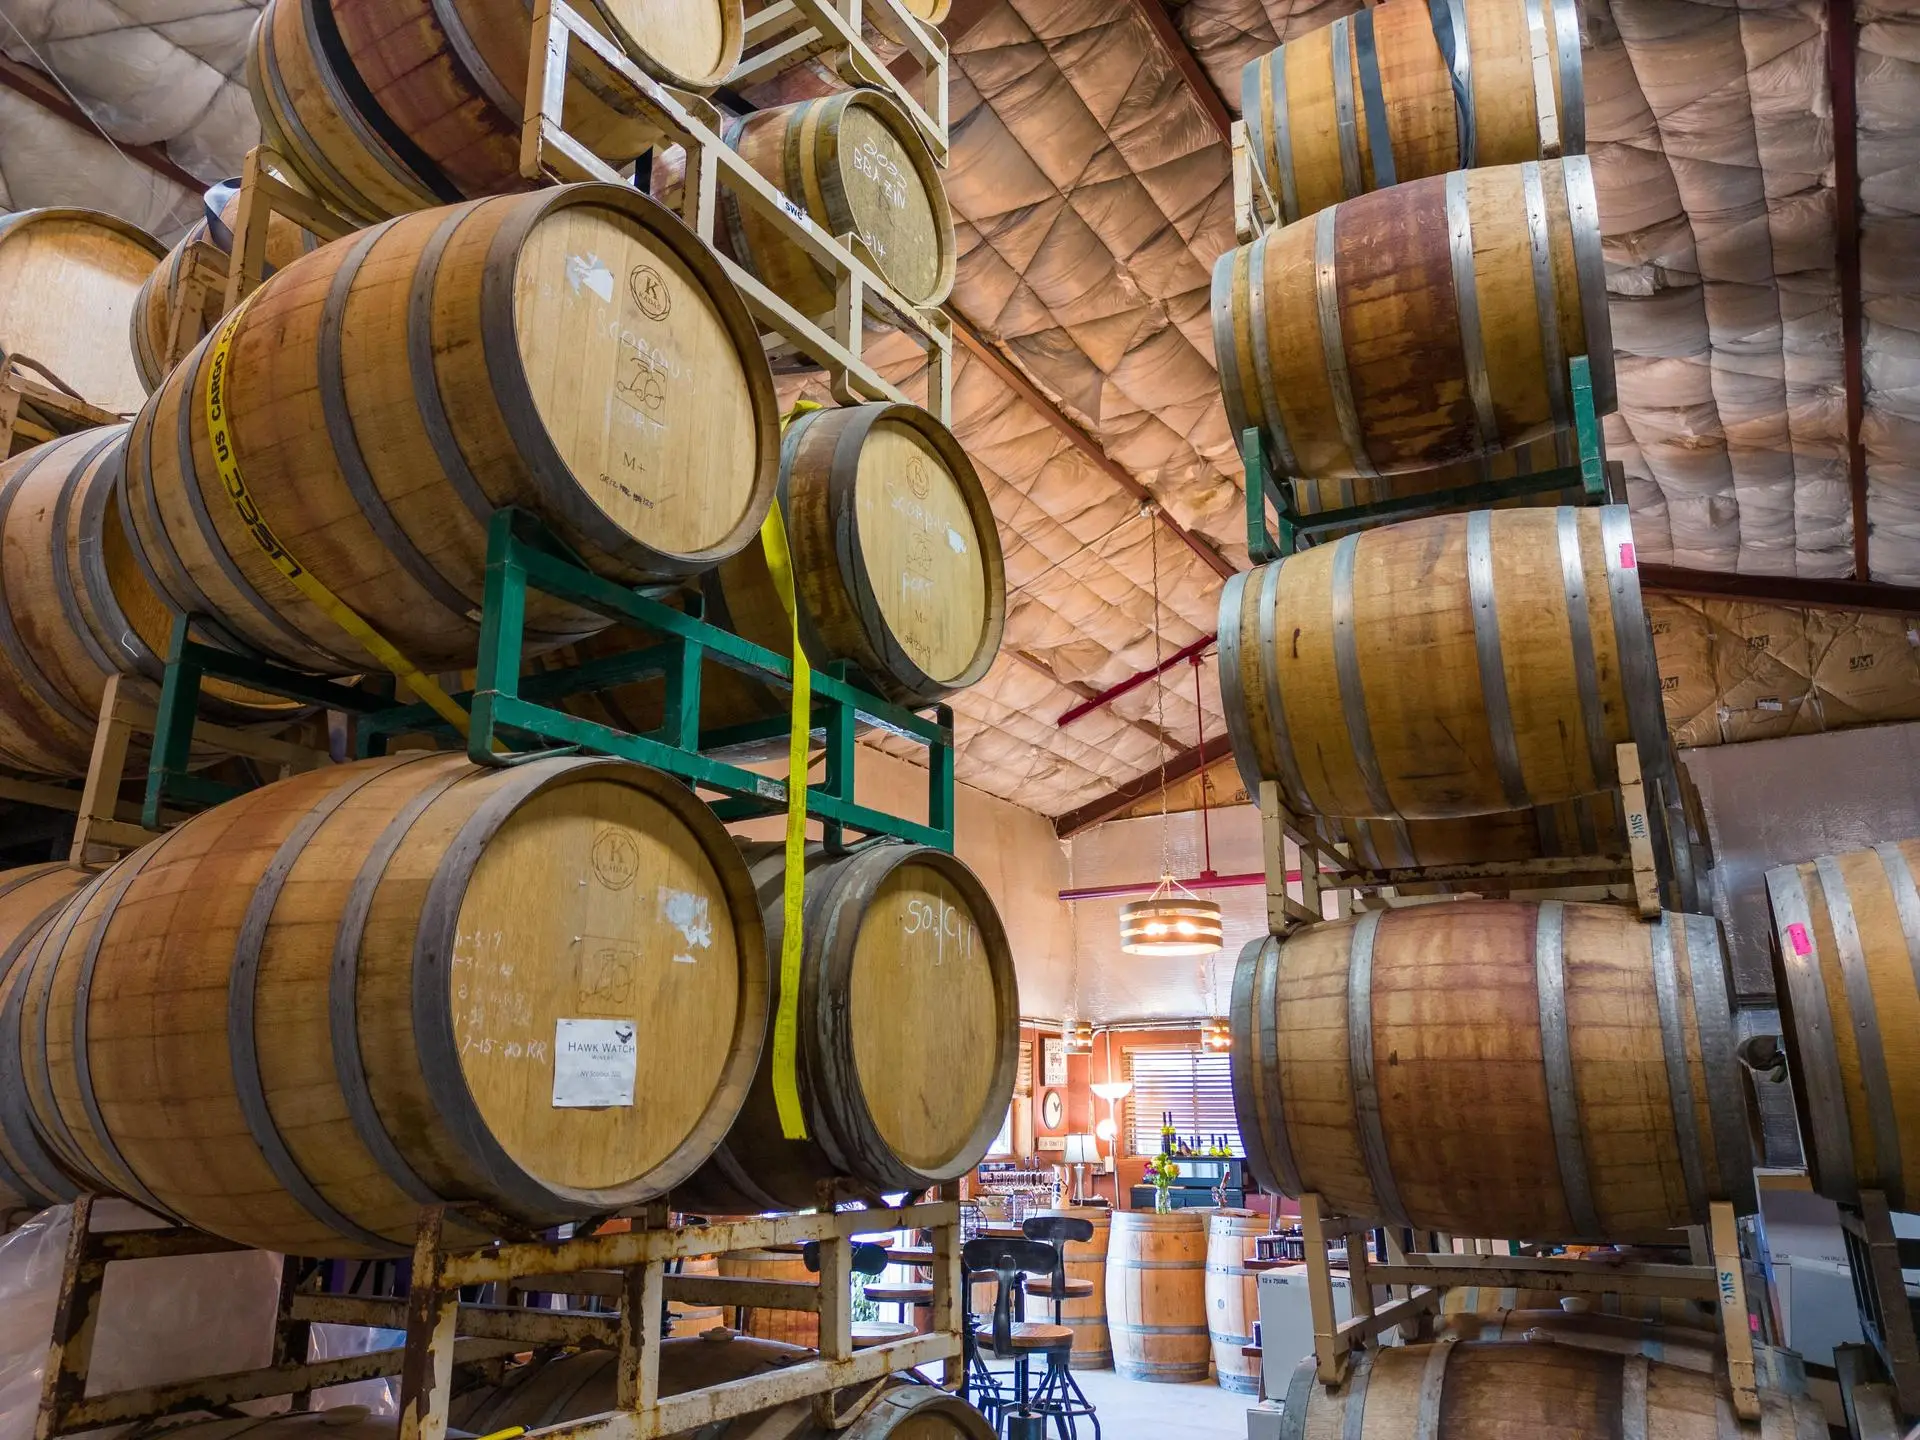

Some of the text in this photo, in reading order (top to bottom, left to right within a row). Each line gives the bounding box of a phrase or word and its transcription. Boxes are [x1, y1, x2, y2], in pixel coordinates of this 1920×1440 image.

[785, 201, 803, 221] SWC
[211, 352, 225, 422] CARGO
[214, 430, 230, 463] US
[1849, 654, 1874, 671] JM
[568, 1041, 635, 1053] HAWK WATCH
